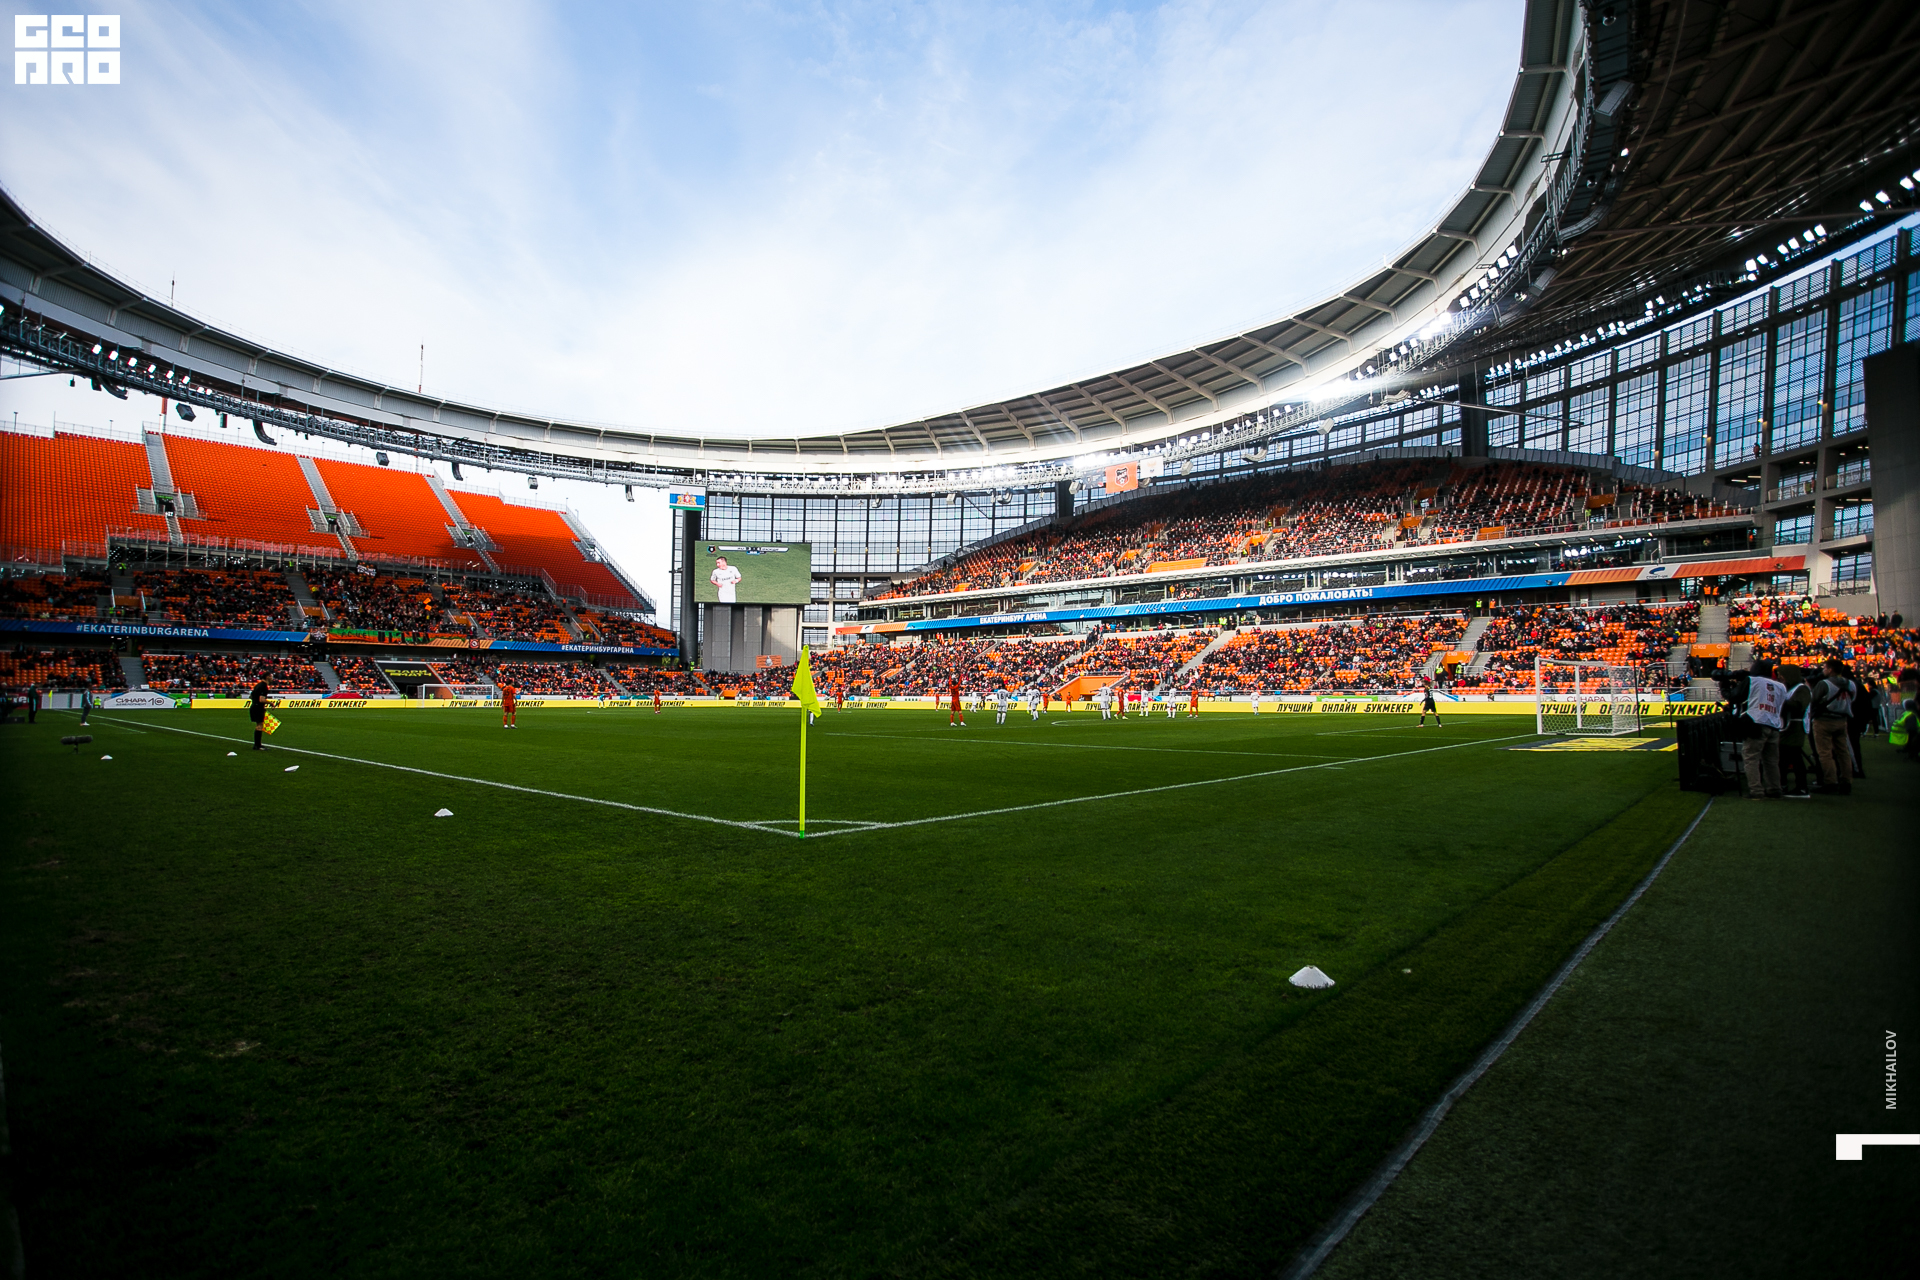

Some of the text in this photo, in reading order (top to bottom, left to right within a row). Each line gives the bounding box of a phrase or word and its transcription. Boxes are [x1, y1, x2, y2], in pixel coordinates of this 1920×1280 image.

[1259, 588, 1373, 606] ДОБРО ПОЖАЛОВАТЬ!
[980, 612, 1047, 624] ЕКАТЕРИНБУРГ АРЕНА
[76, 624, 209, 637] #EKATERINBURGARENA
[561, 644, 634, 654] #ЕКАТЕРИНБУРГАРЕНА
[288, 700, 321, 708] ОНЛАЙН
[449, 700, 478, 708] ЛУЧШИЙ
[1277, 702, 1414, 712] ЛУЧШИЙ ОНЛАЙН БУКМЕКЕР
